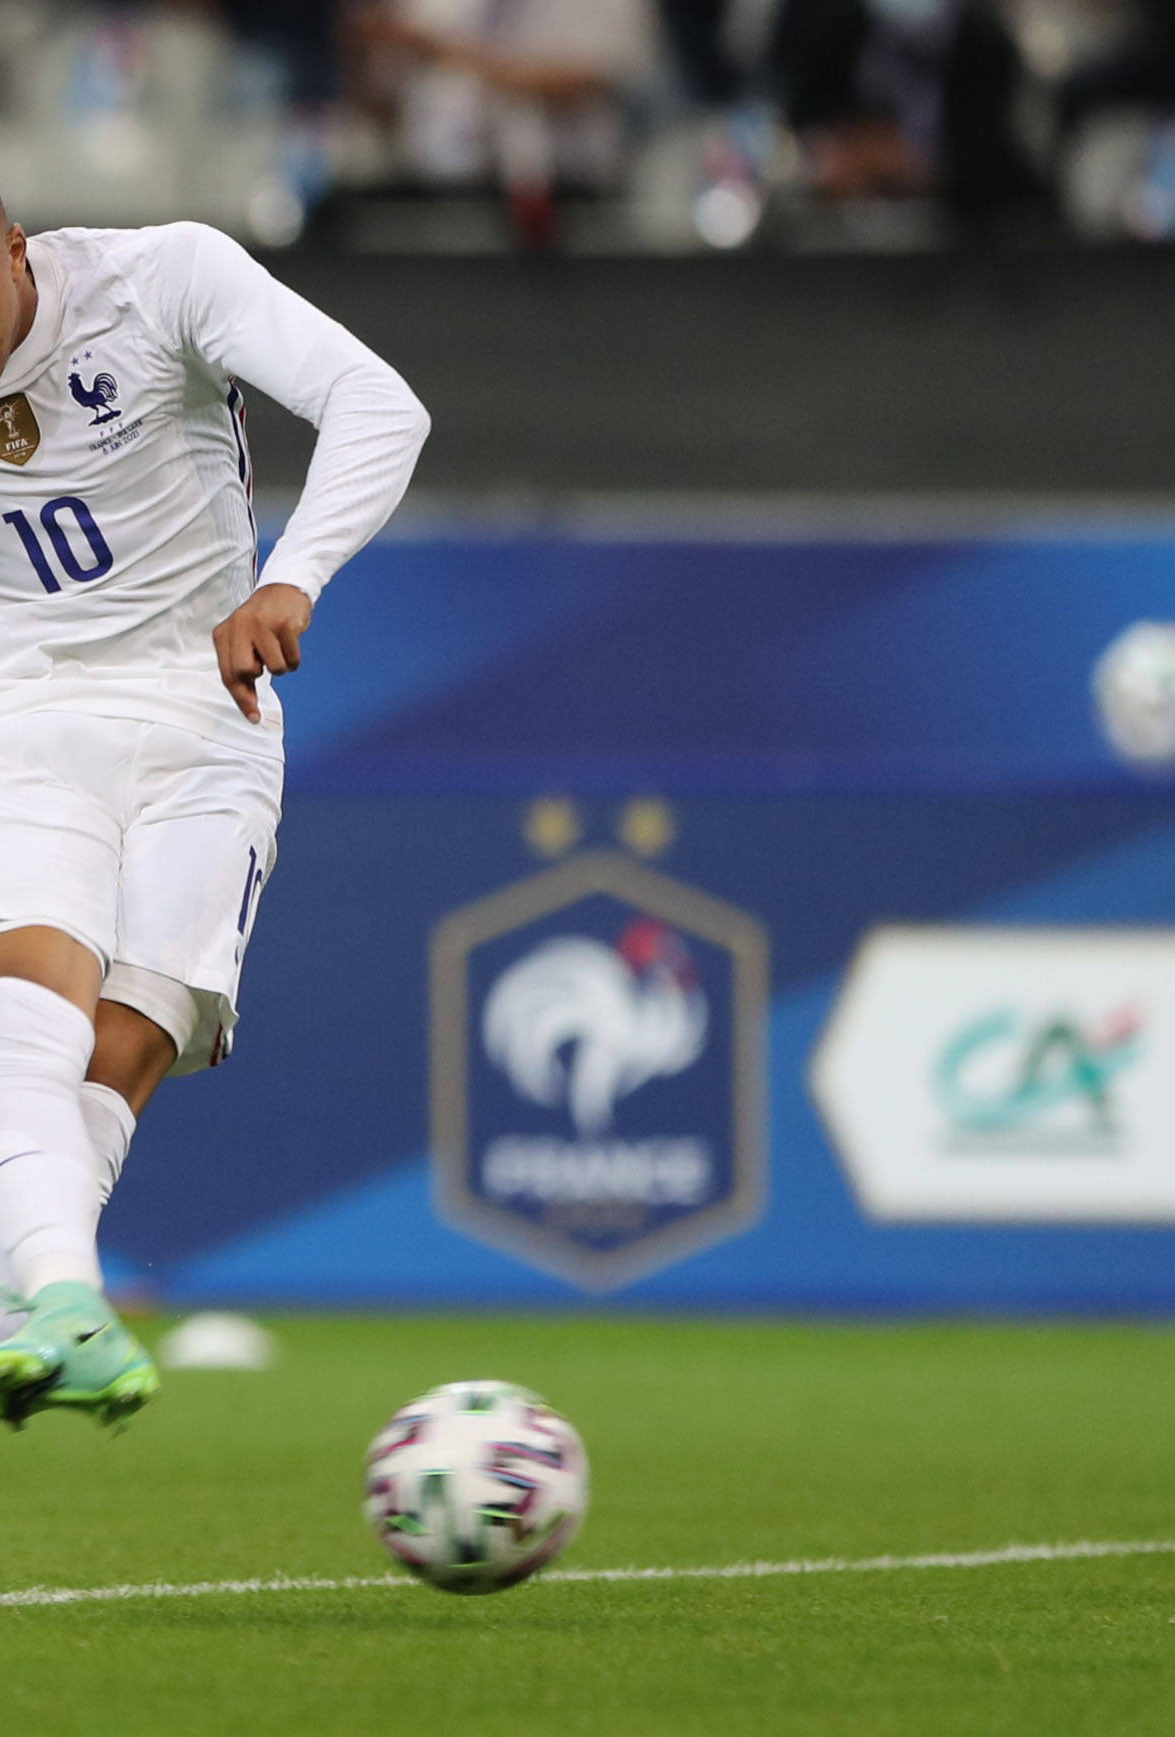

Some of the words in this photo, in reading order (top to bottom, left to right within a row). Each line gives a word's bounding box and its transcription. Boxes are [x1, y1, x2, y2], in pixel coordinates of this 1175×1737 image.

[5, 438, 28, 451] FIFA
[2, 496, 114, 594] 10
[483, 1138, 708, 1203] FRANCE
